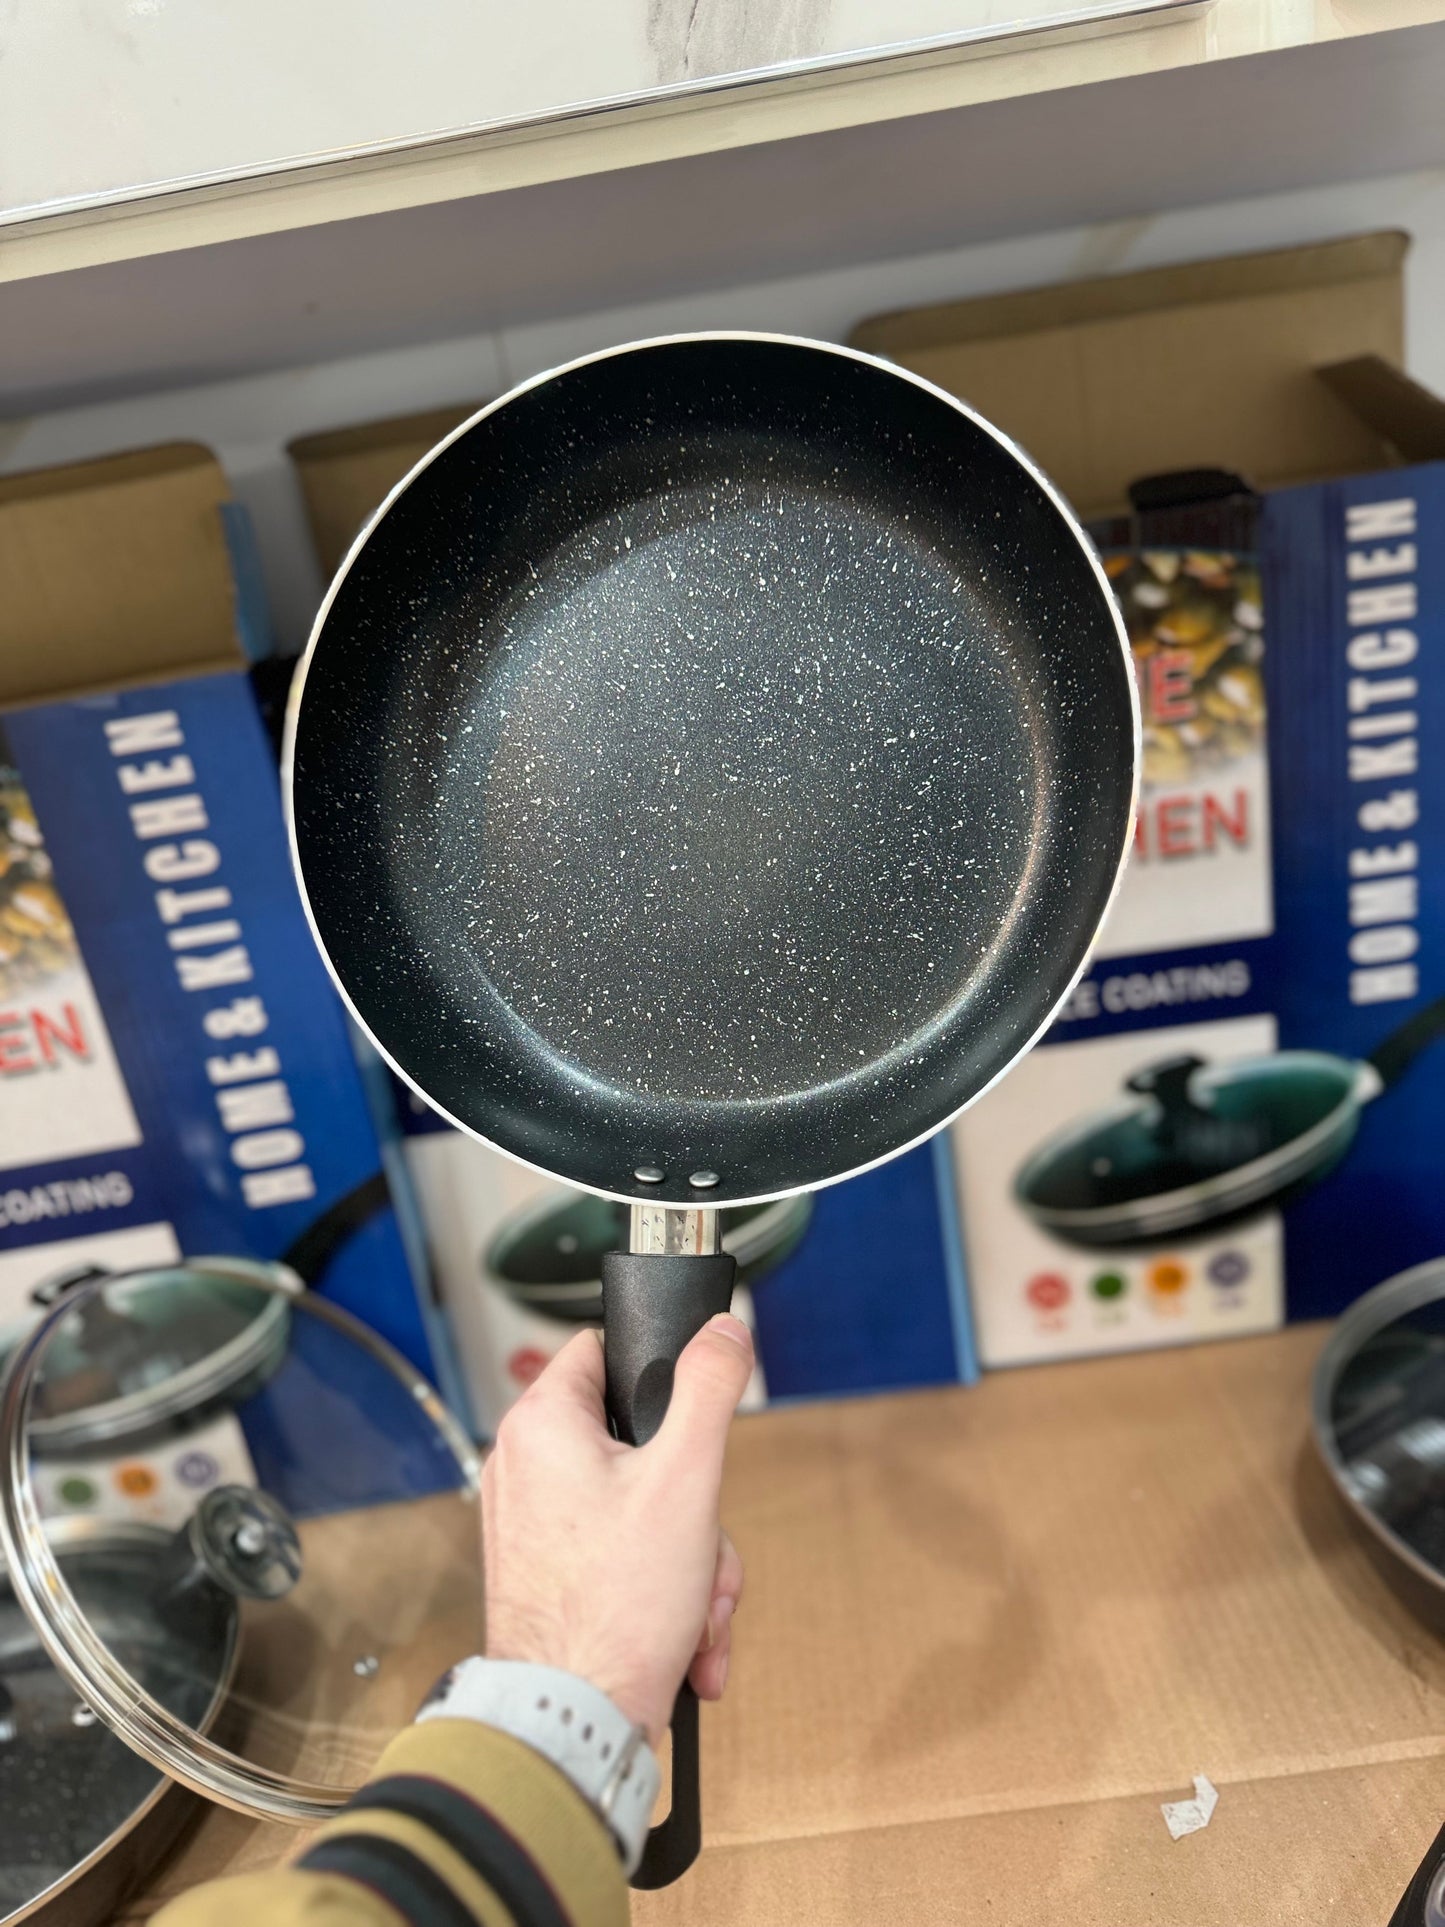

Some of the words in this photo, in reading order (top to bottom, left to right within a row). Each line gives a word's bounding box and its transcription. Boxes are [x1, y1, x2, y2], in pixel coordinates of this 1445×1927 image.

[1346, 497, 1418, 782] KITCHEN
[104, 709, 254, 993] KITCHEN
[1358, 790, 1419, 831] &
[1101, 958, 1251, 1015] COATING
[1349, 840, 1418, 1005] HOME
[203, 995, 268, 1040] &
[206, 1045, 316, 1209] HOME
